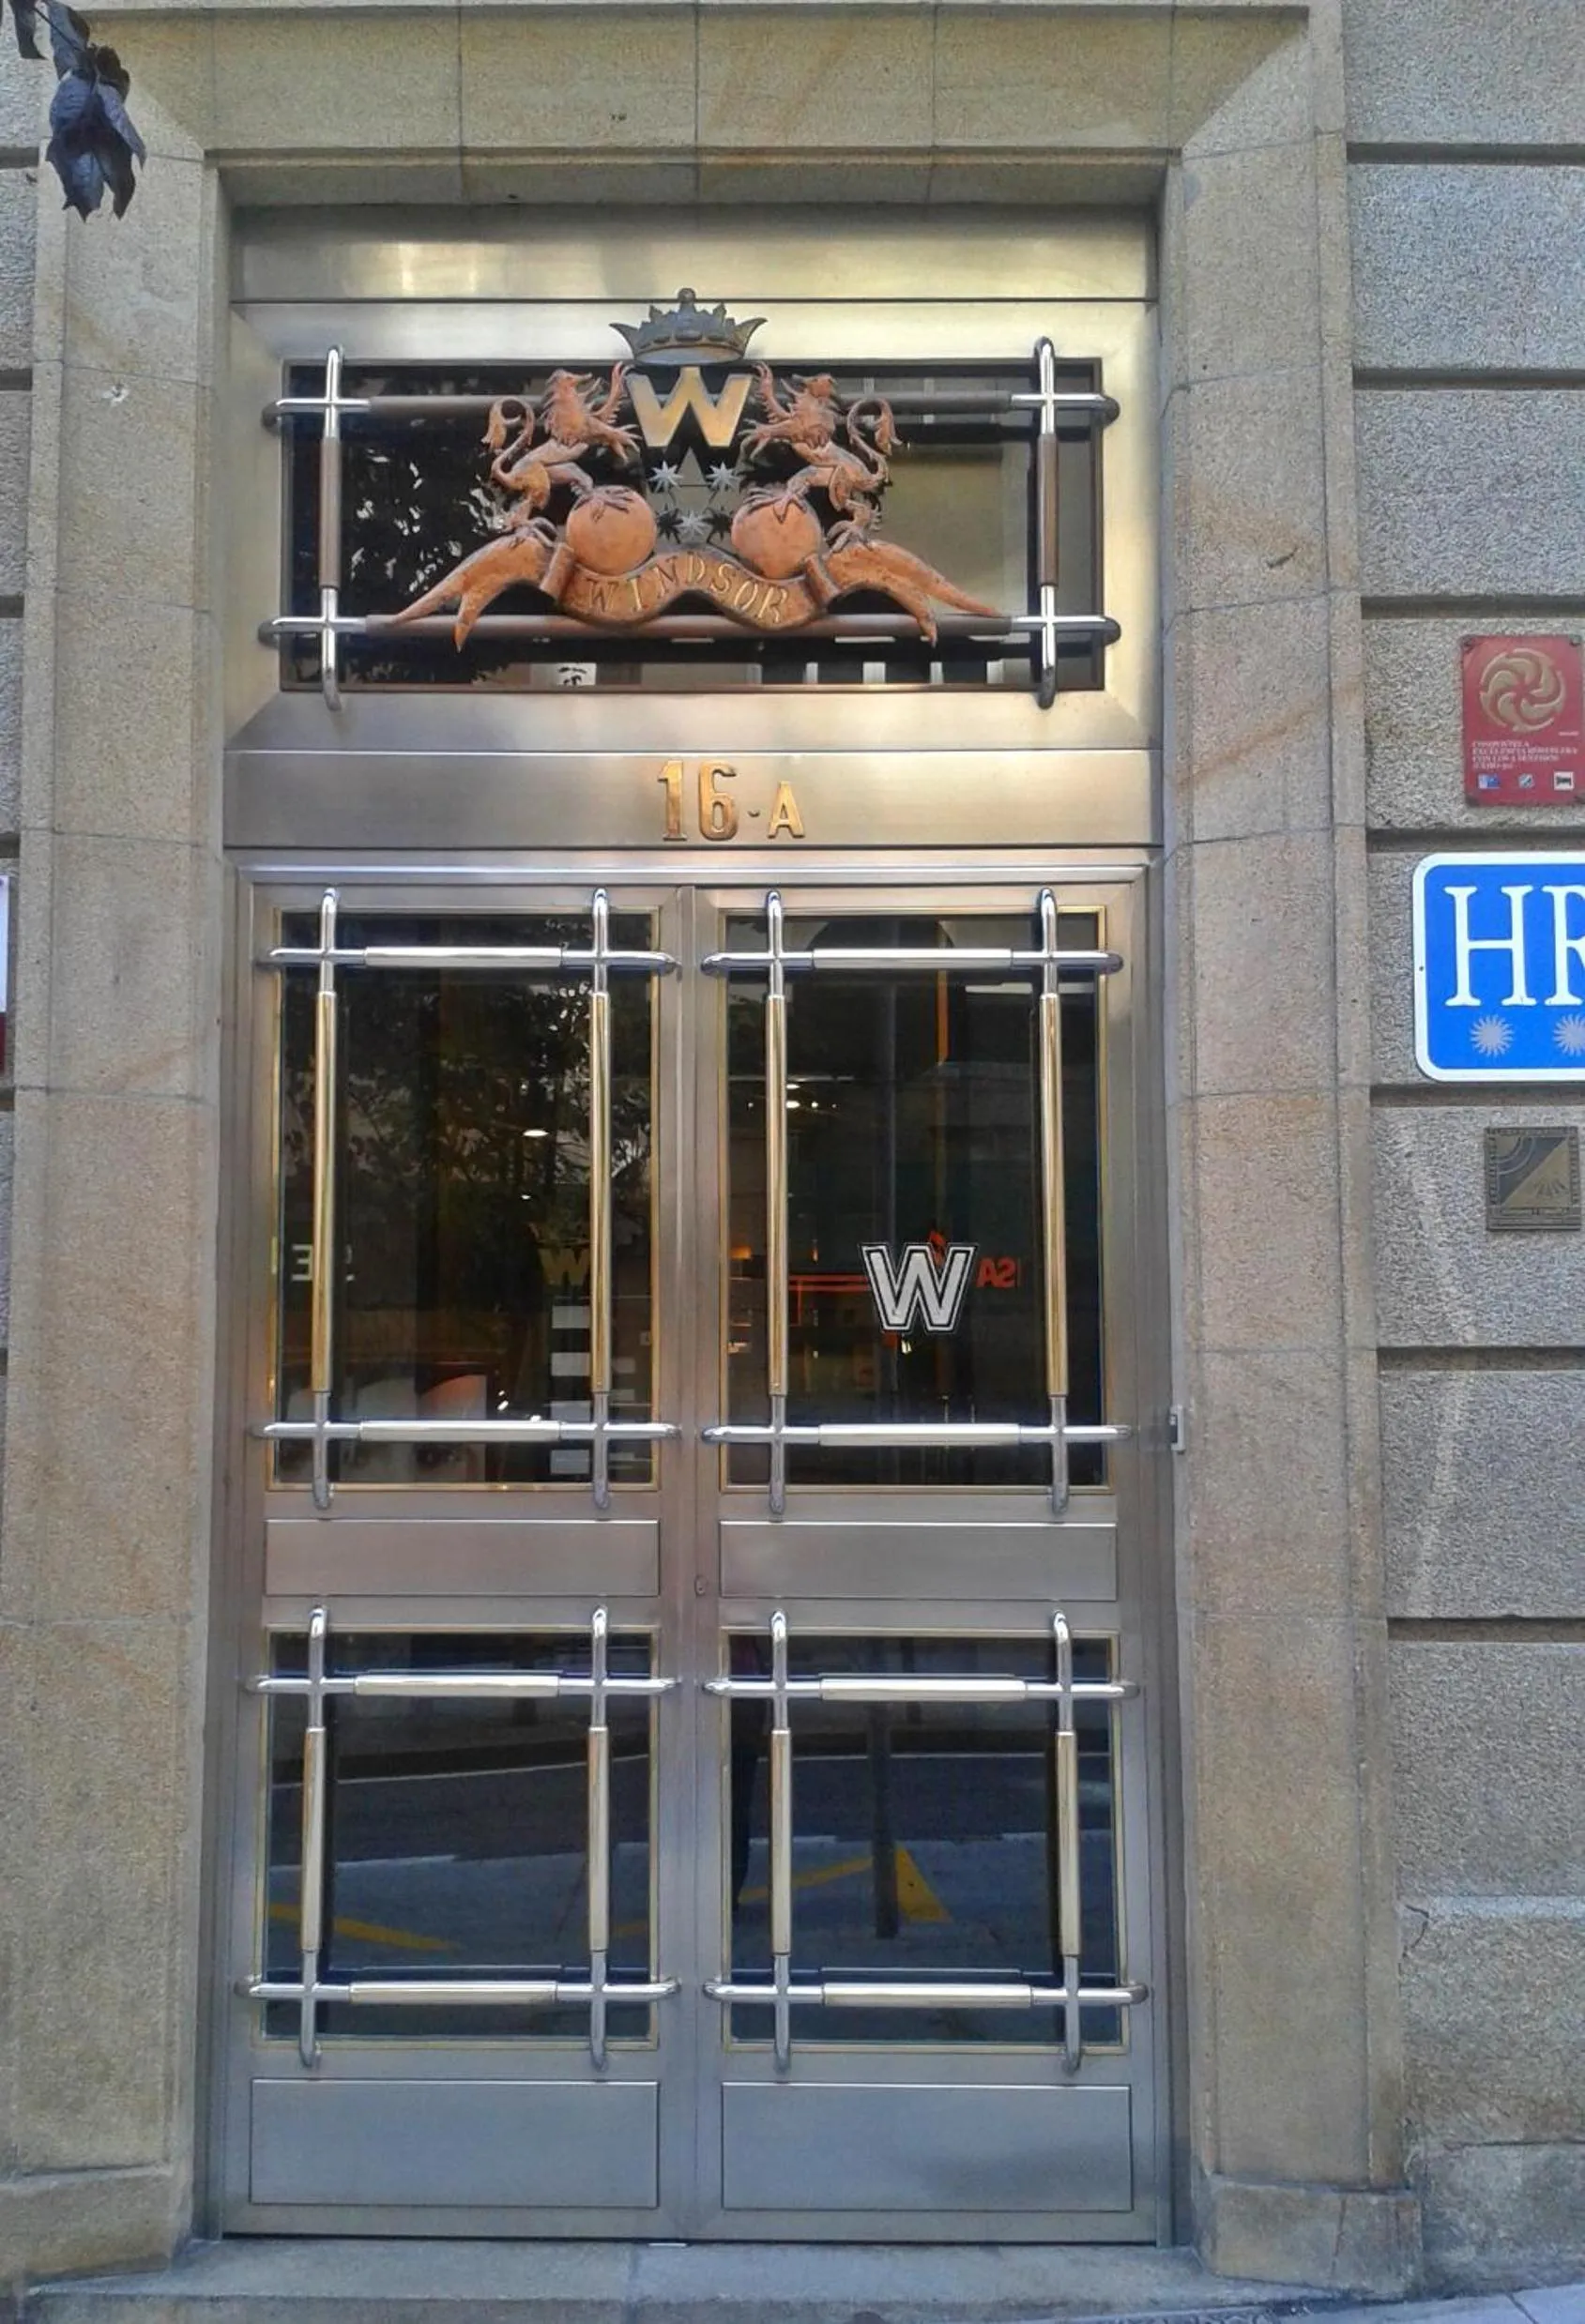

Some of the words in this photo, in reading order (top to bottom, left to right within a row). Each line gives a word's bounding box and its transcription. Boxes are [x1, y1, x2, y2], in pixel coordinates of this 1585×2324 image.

[625, 366, 752, 448] W
[586, 551, 789, 623] WINDSOR
[861, 1243, 977, 1332] W
